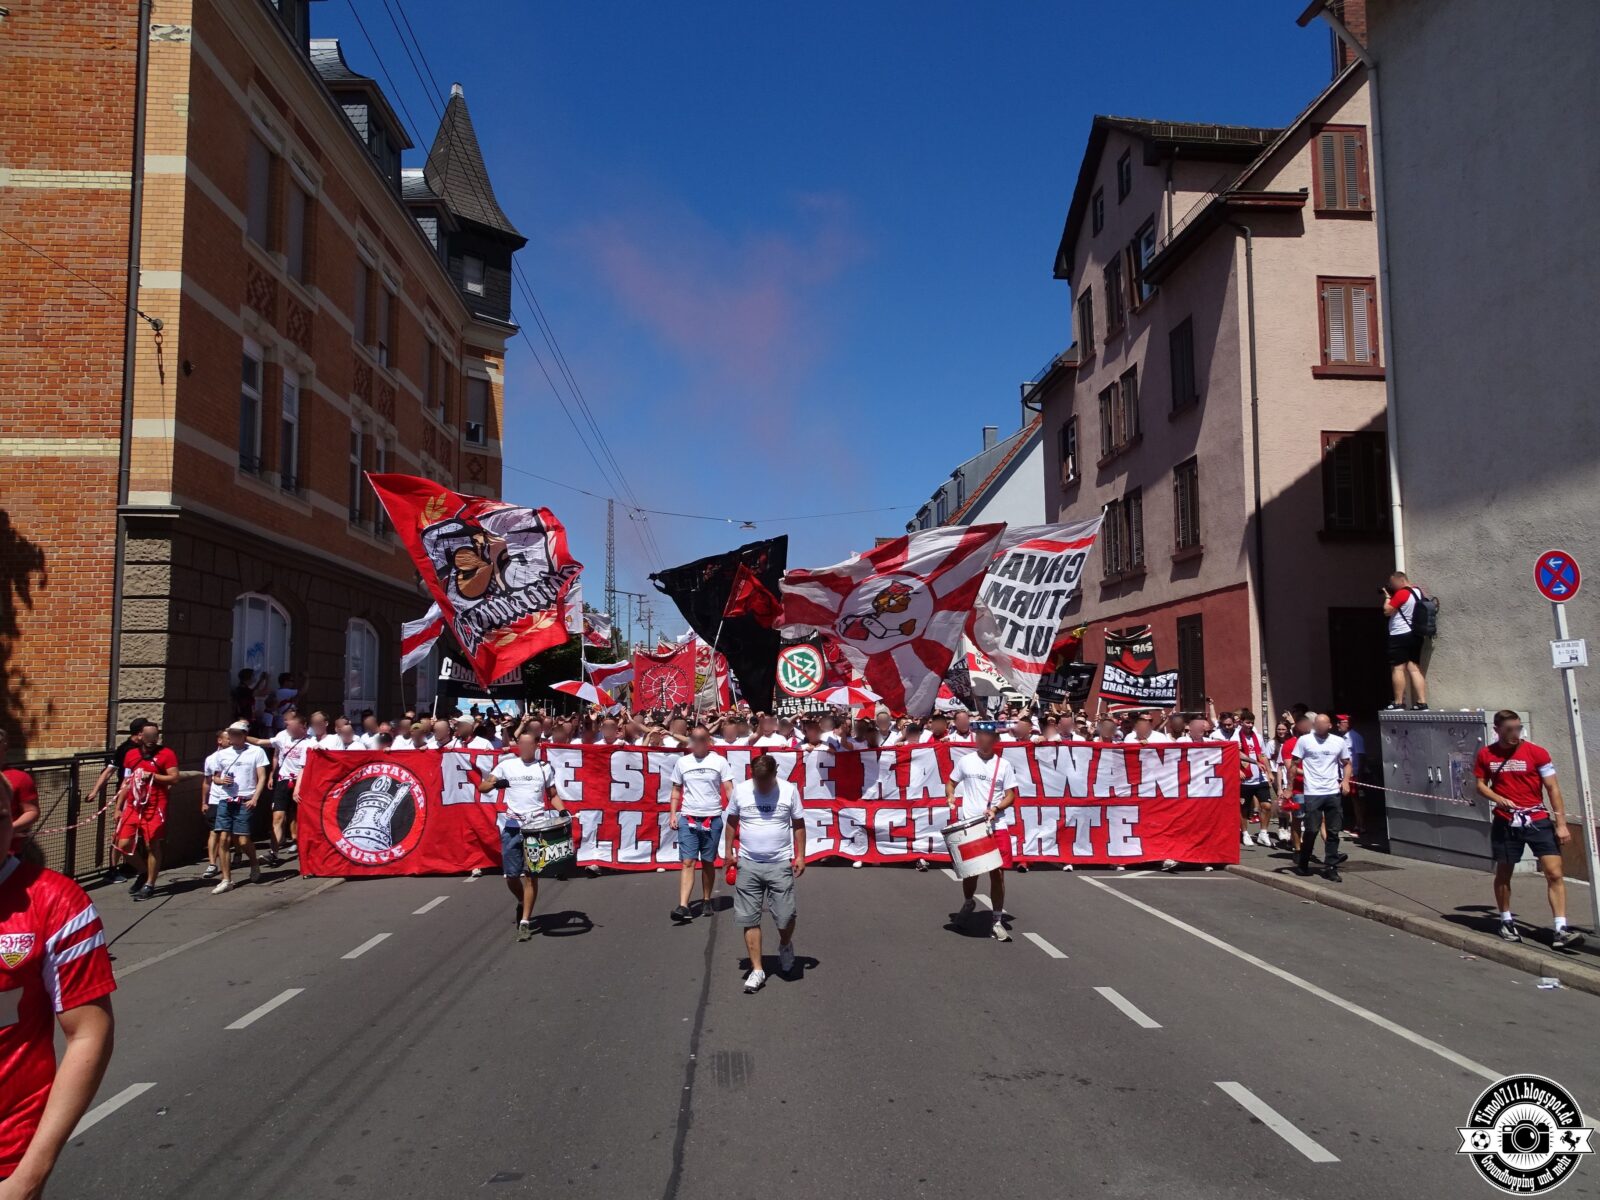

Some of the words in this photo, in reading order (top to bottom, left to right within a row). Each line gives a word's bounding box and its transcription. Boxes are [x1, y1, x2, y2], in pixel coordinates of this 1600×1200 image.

[440, 656, 522, 684] COMDO
[1103, 665, 1145, 687] 50+1
[1149, 672, 1178, 688] IST
[1102, 681, 1177, 697] UNANTASTBAR!
[777, 702, 830, 716] FUSSBALL
[781, 697, 801, 706] FÜR
[610, 750, 836, 804] STLZE
[860, 746, 1224, 801] KAAWANE
[496, 808, 736, 864] LLE
[790, 803, 1144, 861] ESCHHTE
[335, 838, 406, 863] KURVE
